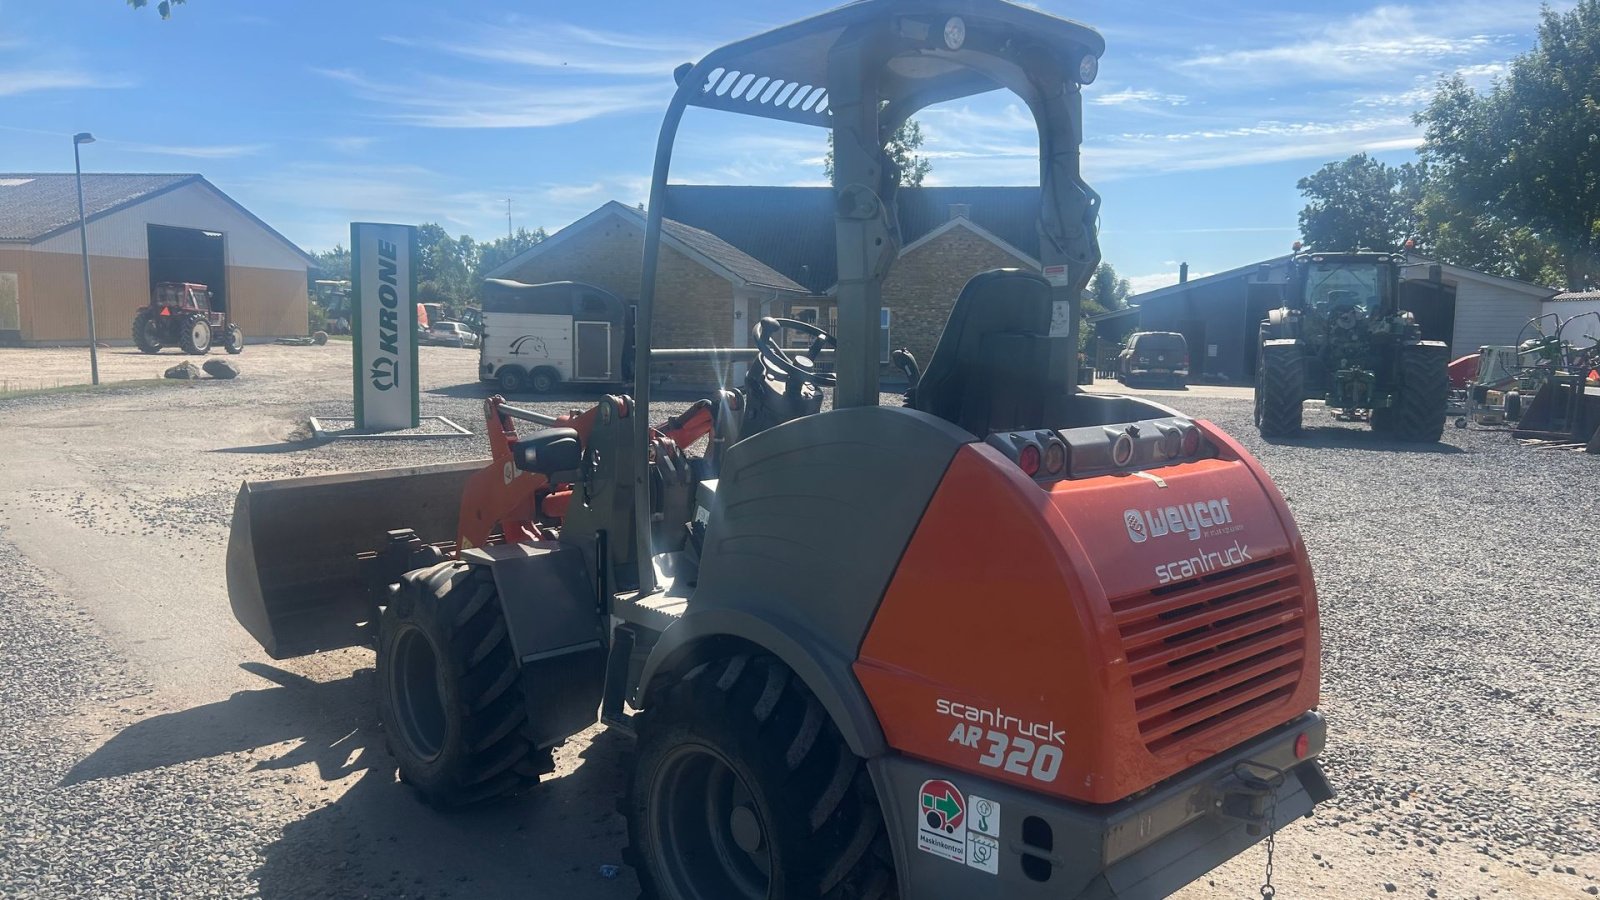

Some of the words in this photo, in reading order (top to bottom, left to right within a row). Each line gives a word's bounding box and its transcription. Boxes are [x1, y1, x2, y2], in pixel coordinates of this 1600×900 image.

[378, 239, 399, 355] KRONE
[1144, 497, 1232, 540] weycor
[1155, 540, 1252, 584] scantruck
[936, 699, 1065, 745] scantruck
[948, 722, 983, 749] AR
[979, 730, 1063, 782] 320
[920, 835, 964, 854] Maskinkontrol
